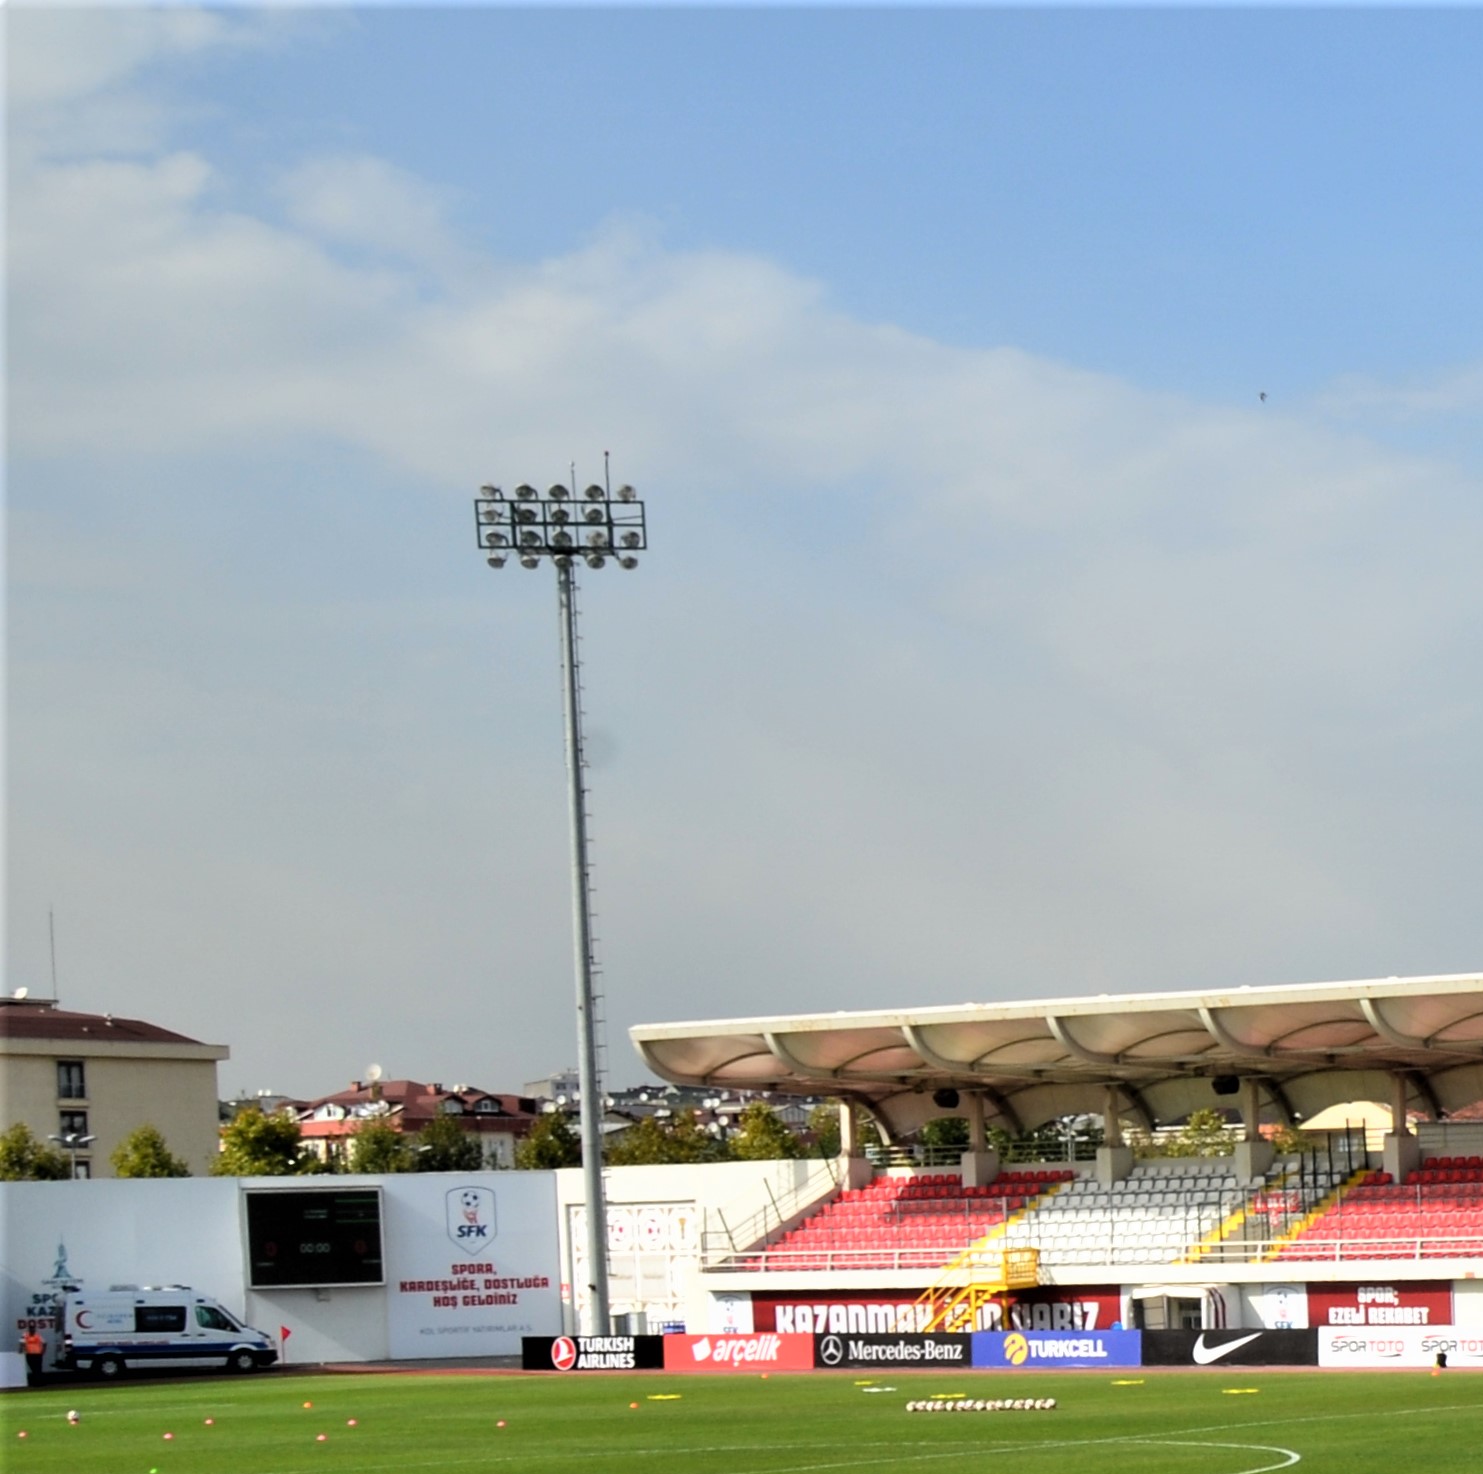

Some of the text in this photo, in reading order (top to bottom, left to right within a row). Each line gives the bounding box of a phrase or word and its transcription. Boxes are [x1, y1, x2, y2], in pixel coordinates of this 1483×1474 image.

[457, 1225, 488, 1238] SFK
[451, 1263, 497, 1276] SPORA,
[433, 1296, 457, 1310] HOŞ
[577, 1336, 635, 1352] TURKISH
[713, 1335, 782, 1367] arçelik
[848, 1340, 963, 1360] Mercedes-Benz
[1028, 1339, 1108, 1358] TURKCELL
[577, 1353, 635, 1369] AIRLINES
